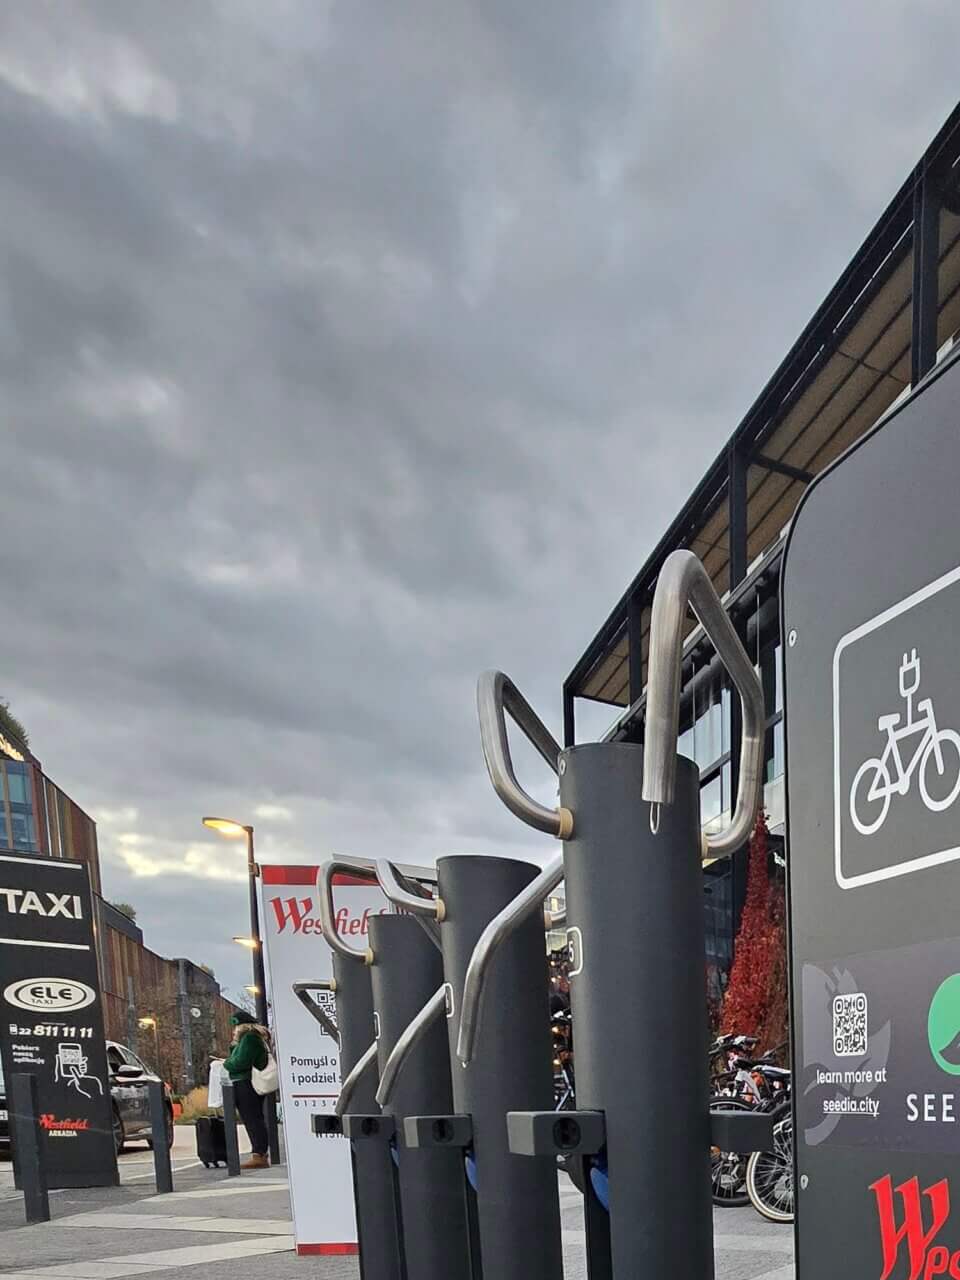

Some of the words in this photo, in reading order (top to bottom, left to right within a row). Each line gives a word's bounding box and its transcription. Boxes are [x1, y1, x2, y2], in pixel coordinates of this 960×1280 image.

[0, 888, 83, 920] TAXI
[268, 896, 388, 935] Wesfiel
[30, 986, 72, 1000] ELE
[33, 1025, 58, 1037] 811
[62, 1026, 76, 1037] 11
[80, 1027, 93, 1038] 11
[290, 1055, 328, 1069] Pomyśl
[330, 1058, 337, 1066] o
[298, 1072, 336, 1085] podziel
[816, 1069, 842, 1084] learn
[844, 1071, 873, 1084] more
[874, 1067, 887, 1083] at
[823, 1096, 880, 1117] seedia.city
